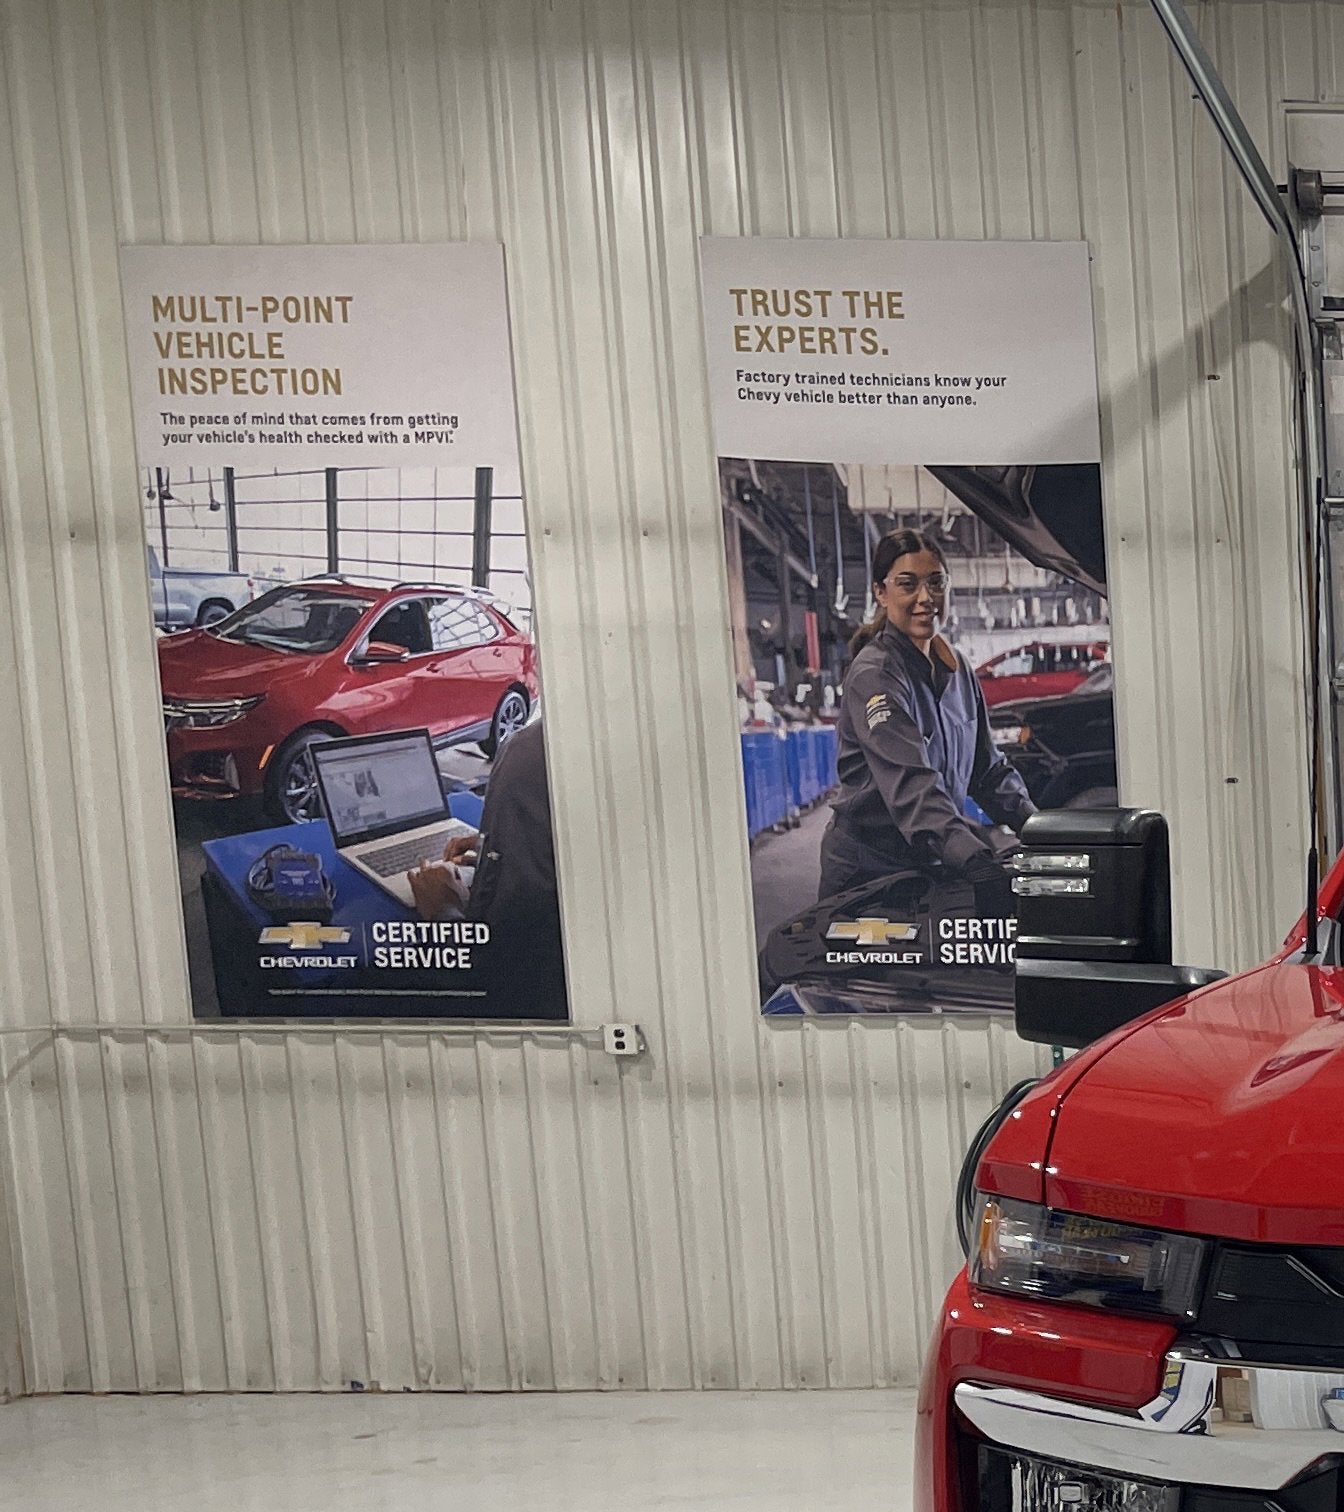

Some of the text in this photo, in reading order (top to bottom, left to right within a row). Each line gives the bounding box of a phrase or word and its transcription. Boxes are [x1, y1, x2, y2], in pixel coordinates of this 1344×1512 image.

[152, 295, 353, 324] MULTI-POINT
[729, 289, 905, 320] TRUST THE
[153, 332, 285, 360] VEHICLE
[734, 325, 889, 356] EXPERTS.
[158, 368, 342, 395] INSPECTION
[736, 369, 1007, 390] Factory trained technicians know your
[738, 387, 977, 408] Chevy vehicle better than anyone.
[160, 412, 459, 429] The peace of mind that comes from getting
[162, 433, 193, 447] your
[196, 430, 255, 444] vehicle's
[259, 430, 303, 444] health
[306, 431, 363, 444] checked
[367, 431, 398, 444] with
[402, 433, 410, 444] a
[372, 922, 490, 944] CERTIFIED
[939, 918, 1018, 939] CERTIF
[259, 956, 358, 968] CHEVROLET
[374, 947, 472, 969] SERVICE
[826, 951, 923, 964] CHEVROLET
[940, 943, 1016, 964] SERVIC
